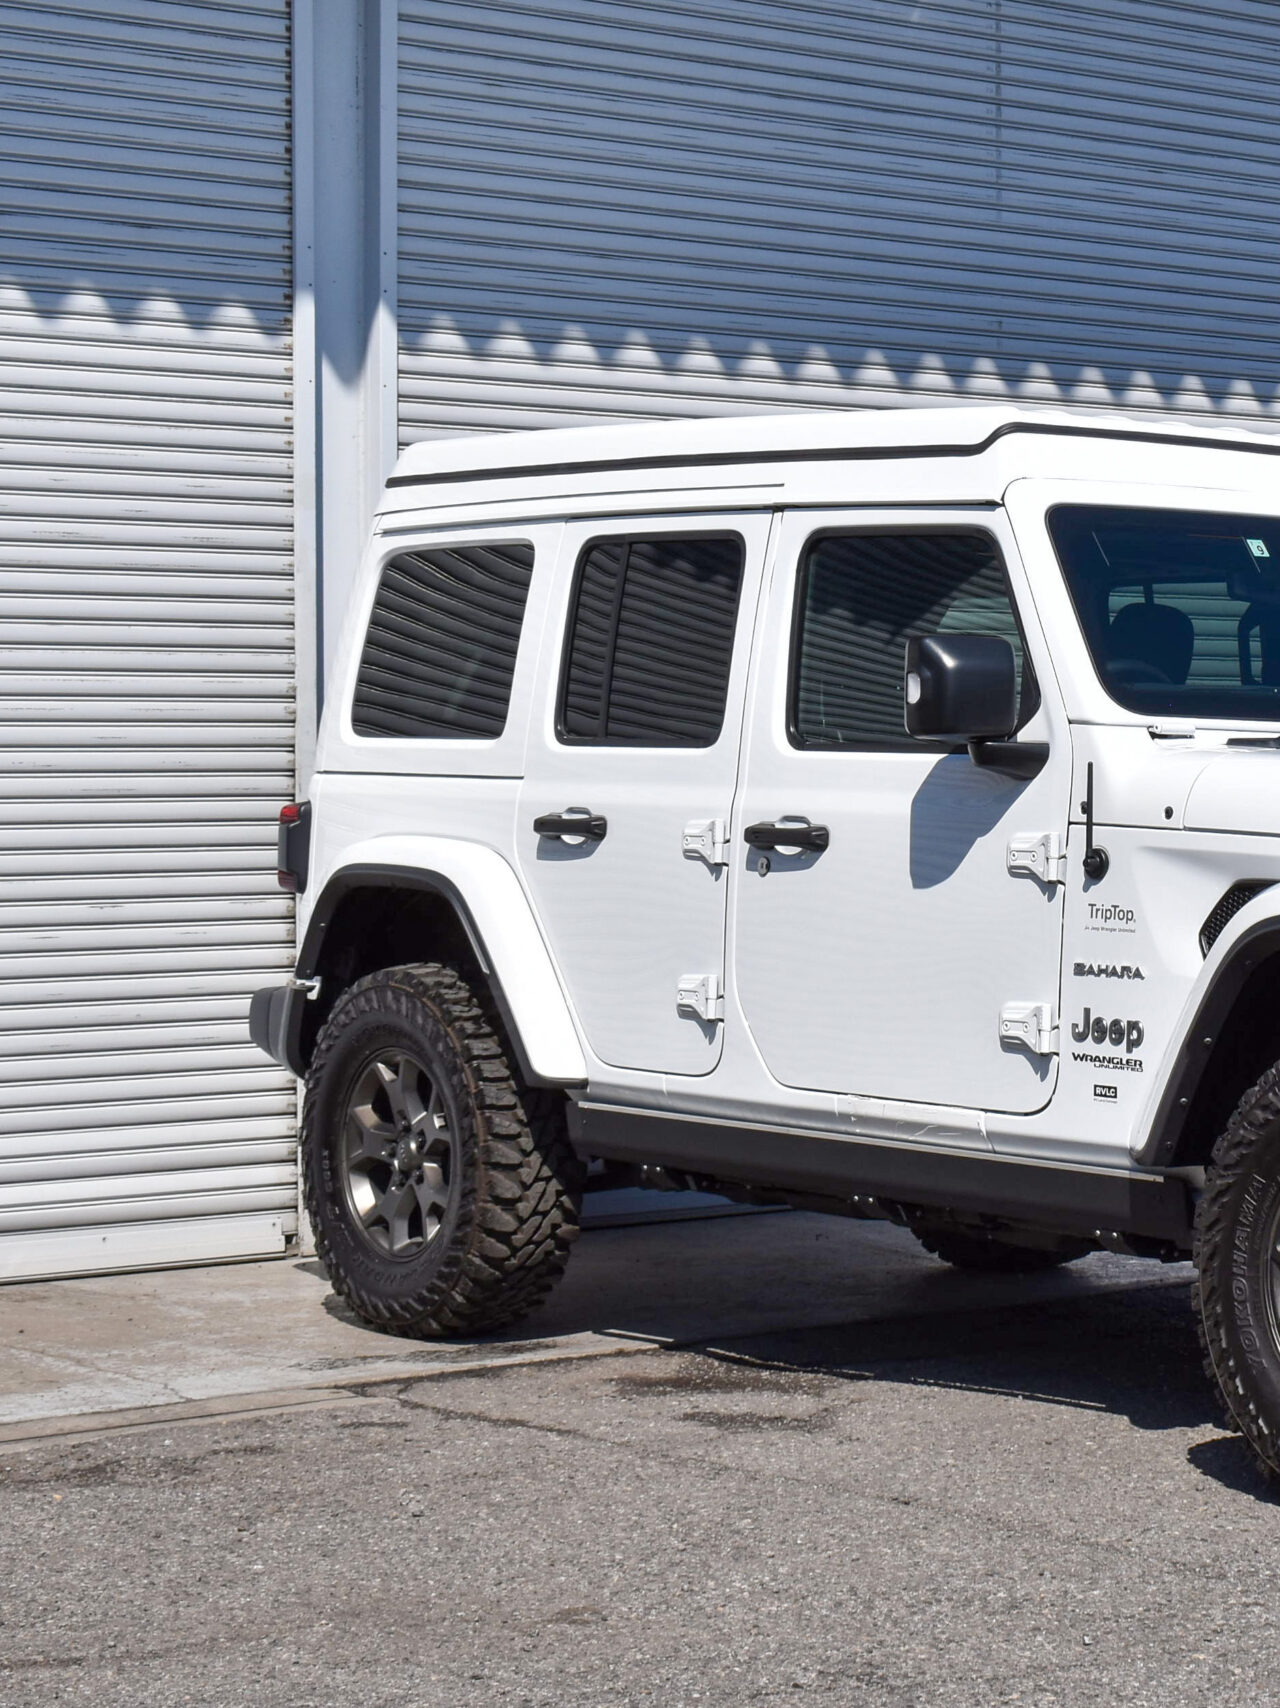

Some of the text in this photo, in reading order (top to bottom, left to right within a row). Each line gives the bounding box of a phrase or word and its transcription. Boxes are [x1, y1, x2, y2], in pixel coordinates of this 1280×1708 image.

[1087, 903, 1134, 924] TripTop
[1073, 962, 1145, 981] SAHARA
[1071, 1007, 1144, 1054] Jeep
[1072, 1052, 1143, 1068] WRANGLER
[1093, 1063, 1143, 1073] UNLIMITED
[1095, 1086, 1116, 1097] RVLC
[1231, 1172, 1268, 1372] YOKOHAMA
